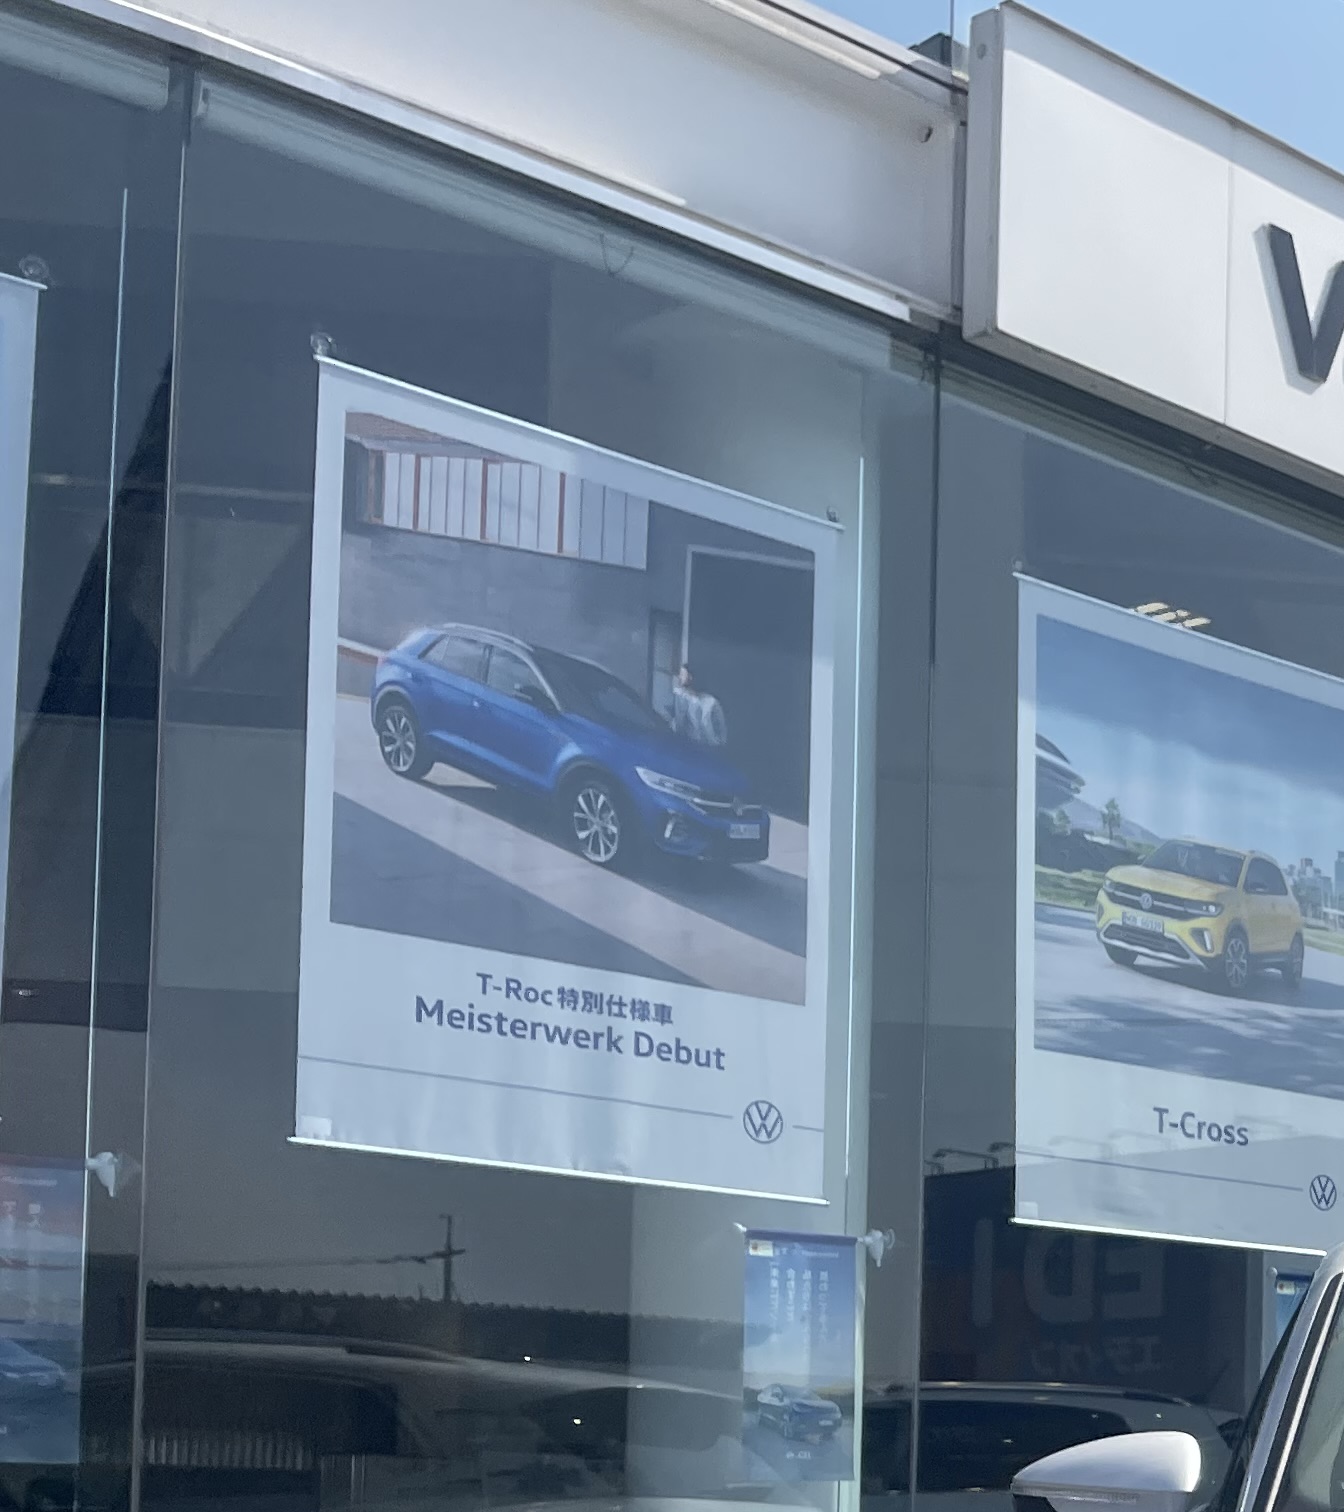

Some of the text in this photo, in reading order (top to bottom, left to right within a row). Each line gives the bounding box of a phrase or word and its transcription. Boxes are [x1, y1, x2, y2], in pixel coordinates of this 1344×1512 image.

[476, 971, 673, 1026] T-Roc 特別仕様車
[415, 995, 726, 1071] Meisterwerk Debut
[1153, 1106, 1249, 1146] T-Cross
